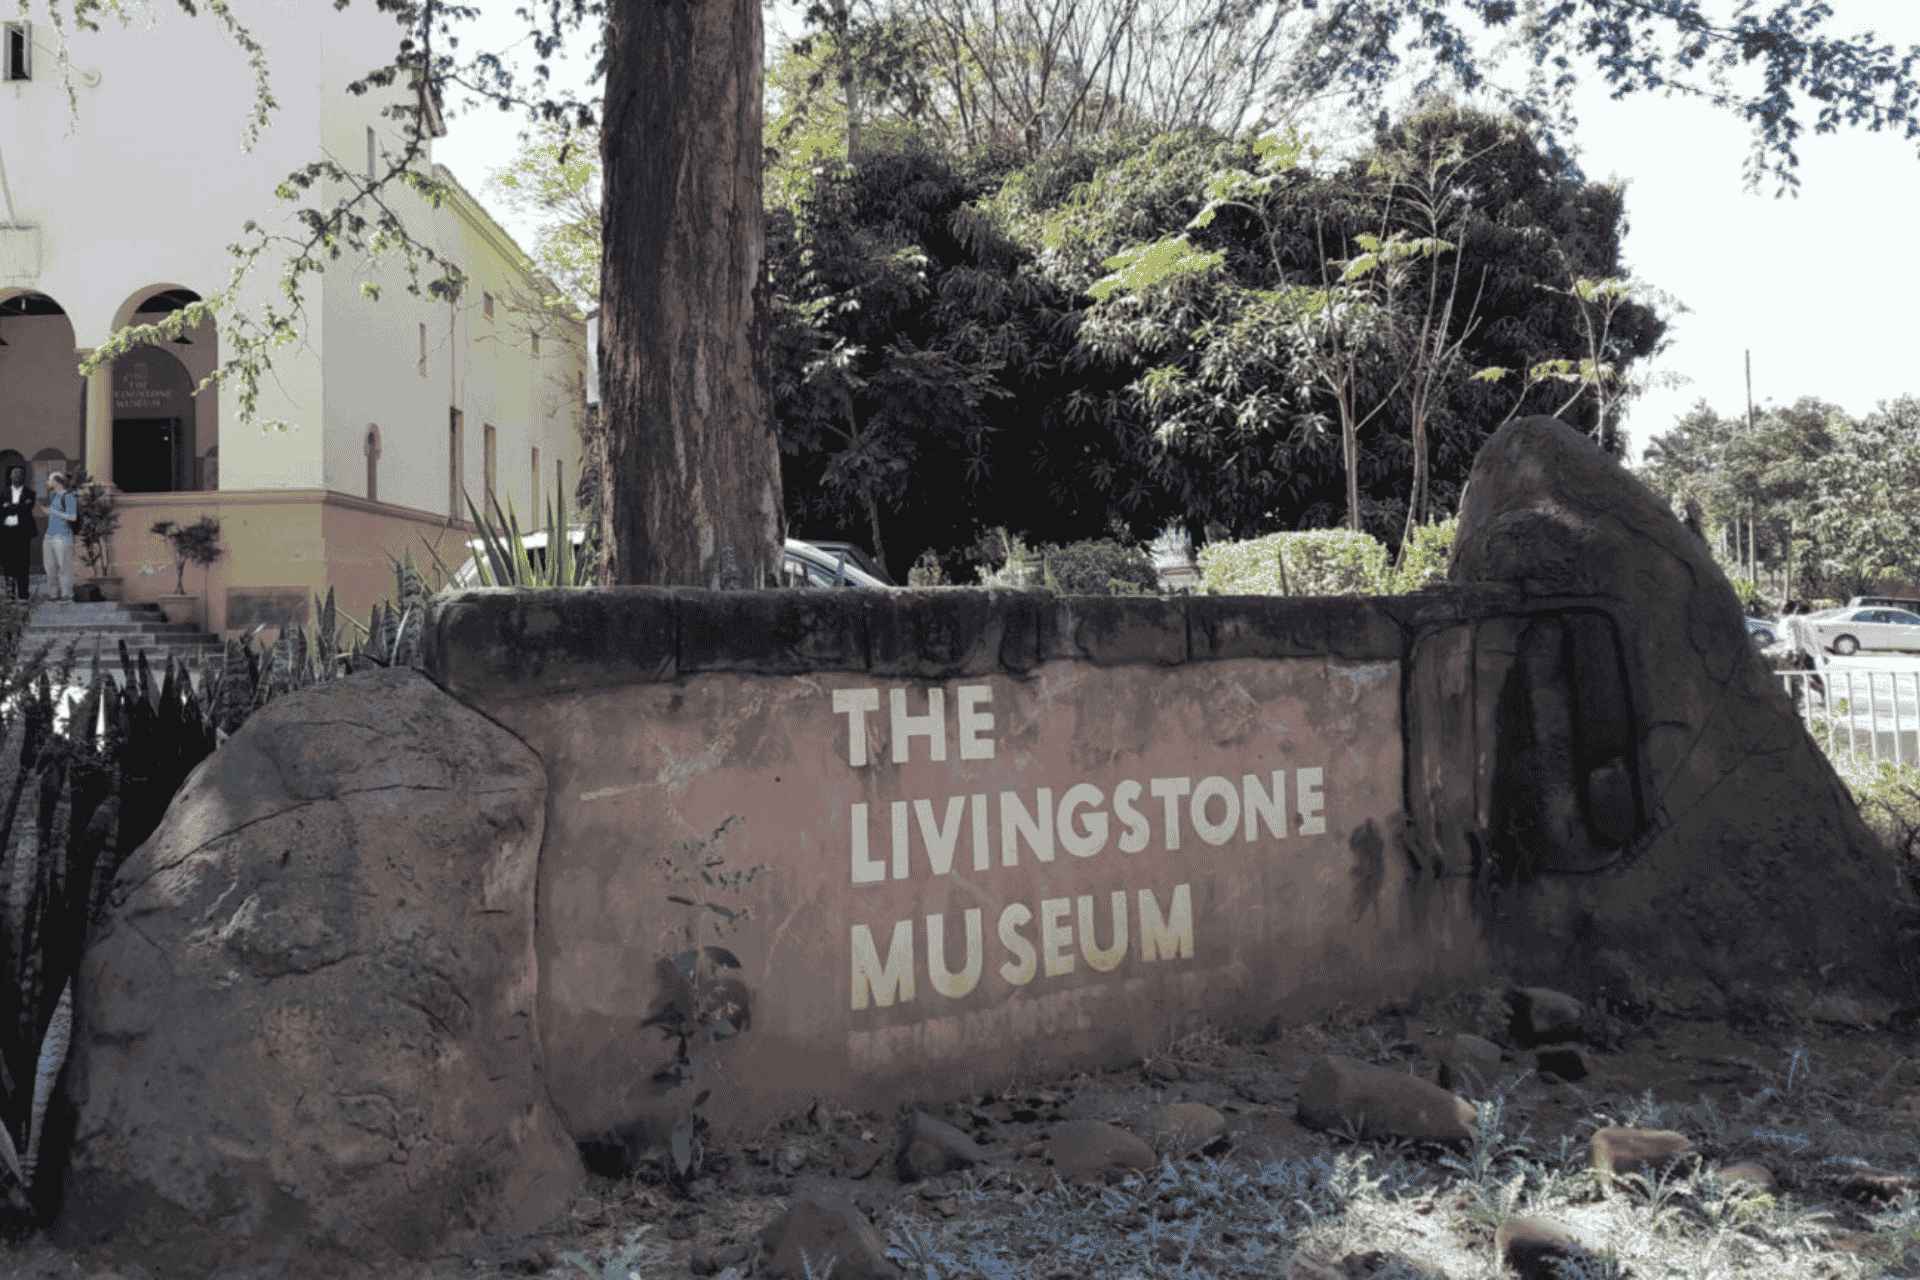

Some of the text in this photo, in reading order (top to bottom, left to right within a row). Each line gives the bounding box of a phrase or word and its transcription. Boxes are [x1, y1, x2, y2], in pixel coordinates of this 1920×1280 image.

[832, 685, 996, 767] THE
[850, 766, 1326, 884] LIVINGSTONE
[850, 884, 1194, 1010] MUSEUM
